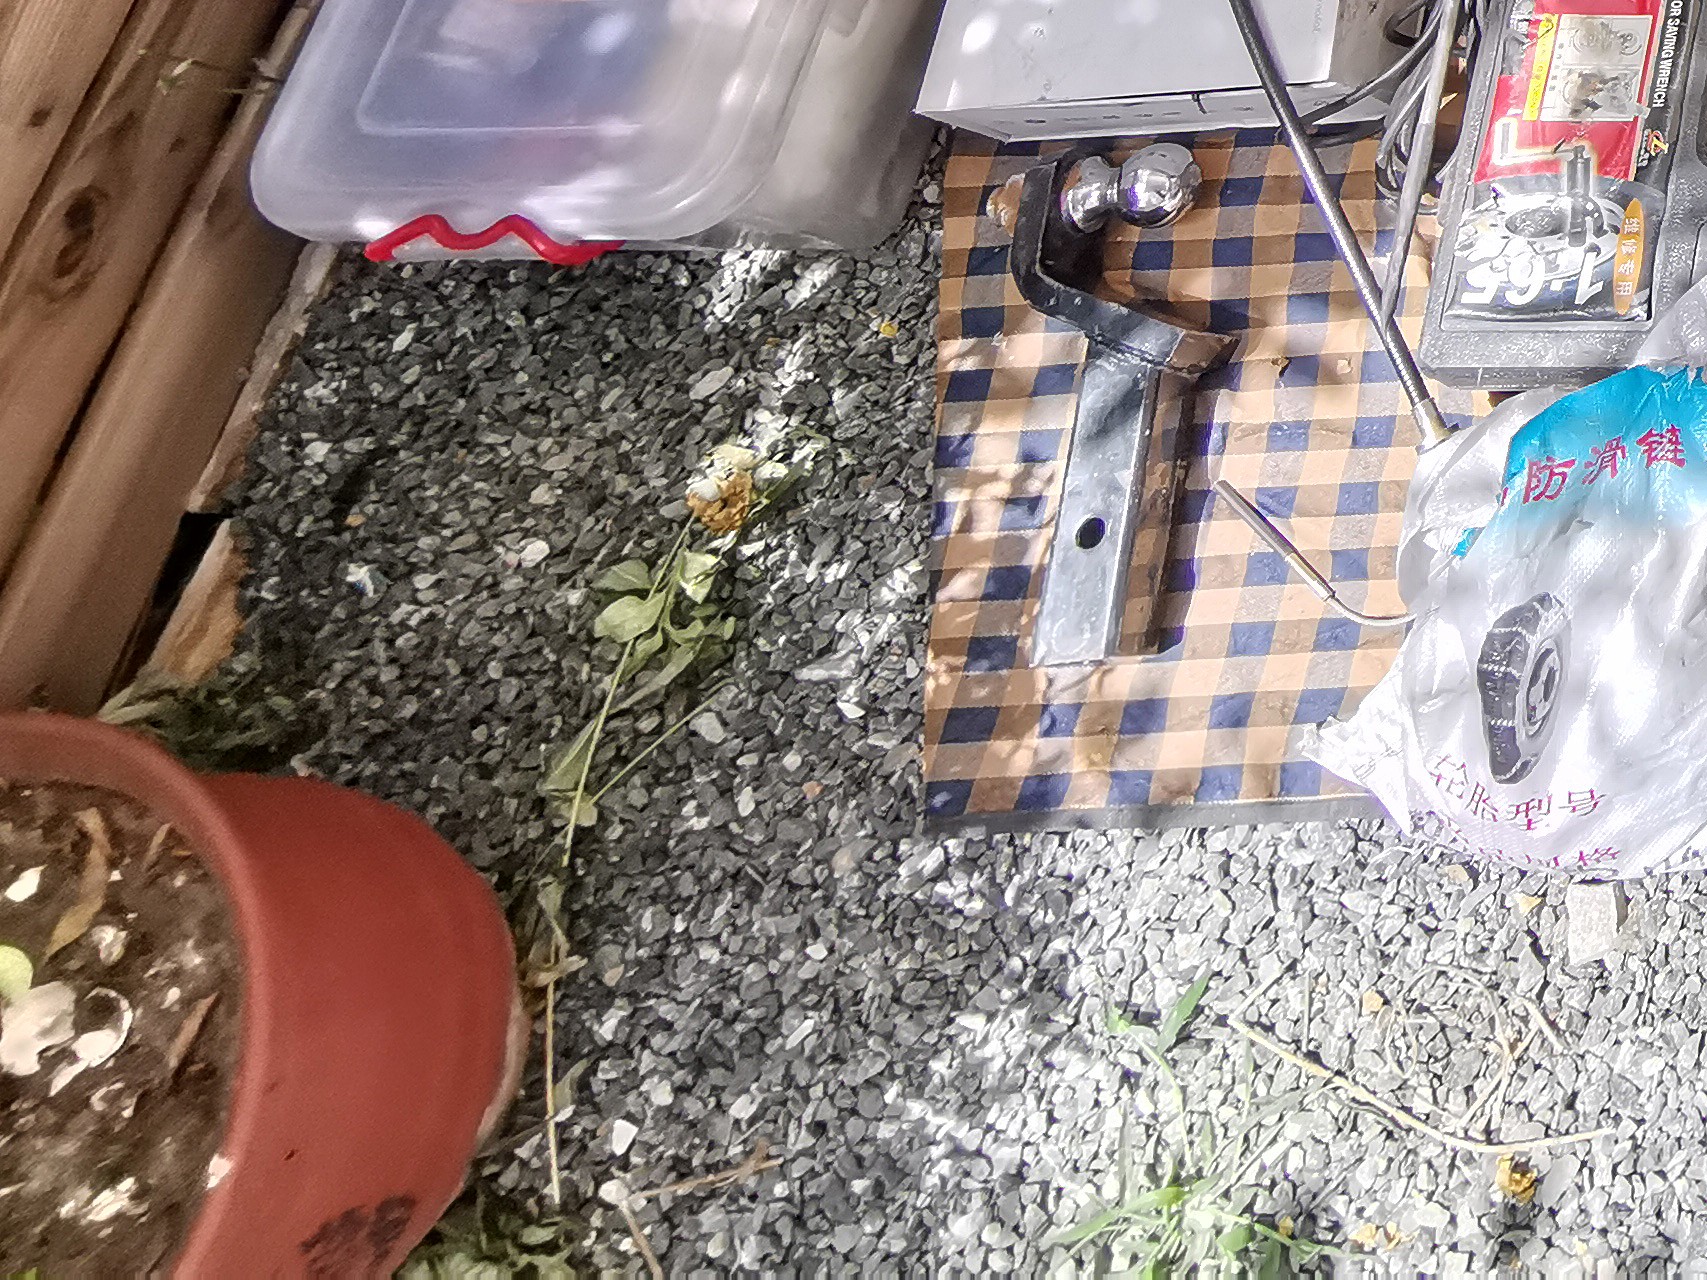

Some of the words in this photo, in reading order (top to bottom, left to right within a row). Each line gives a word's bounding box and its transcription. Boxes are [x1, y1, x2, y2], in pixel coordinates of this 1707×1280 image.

[1659, 18, 1680, 59] SAVING
[1651, 59, 1673, 109] WRENCH
[1614, 216, 1643, 297] 维修专用
[1500, 422, 1687, 506] 防滑链
[1427, 753, 1608, 831] 轮胎型号
